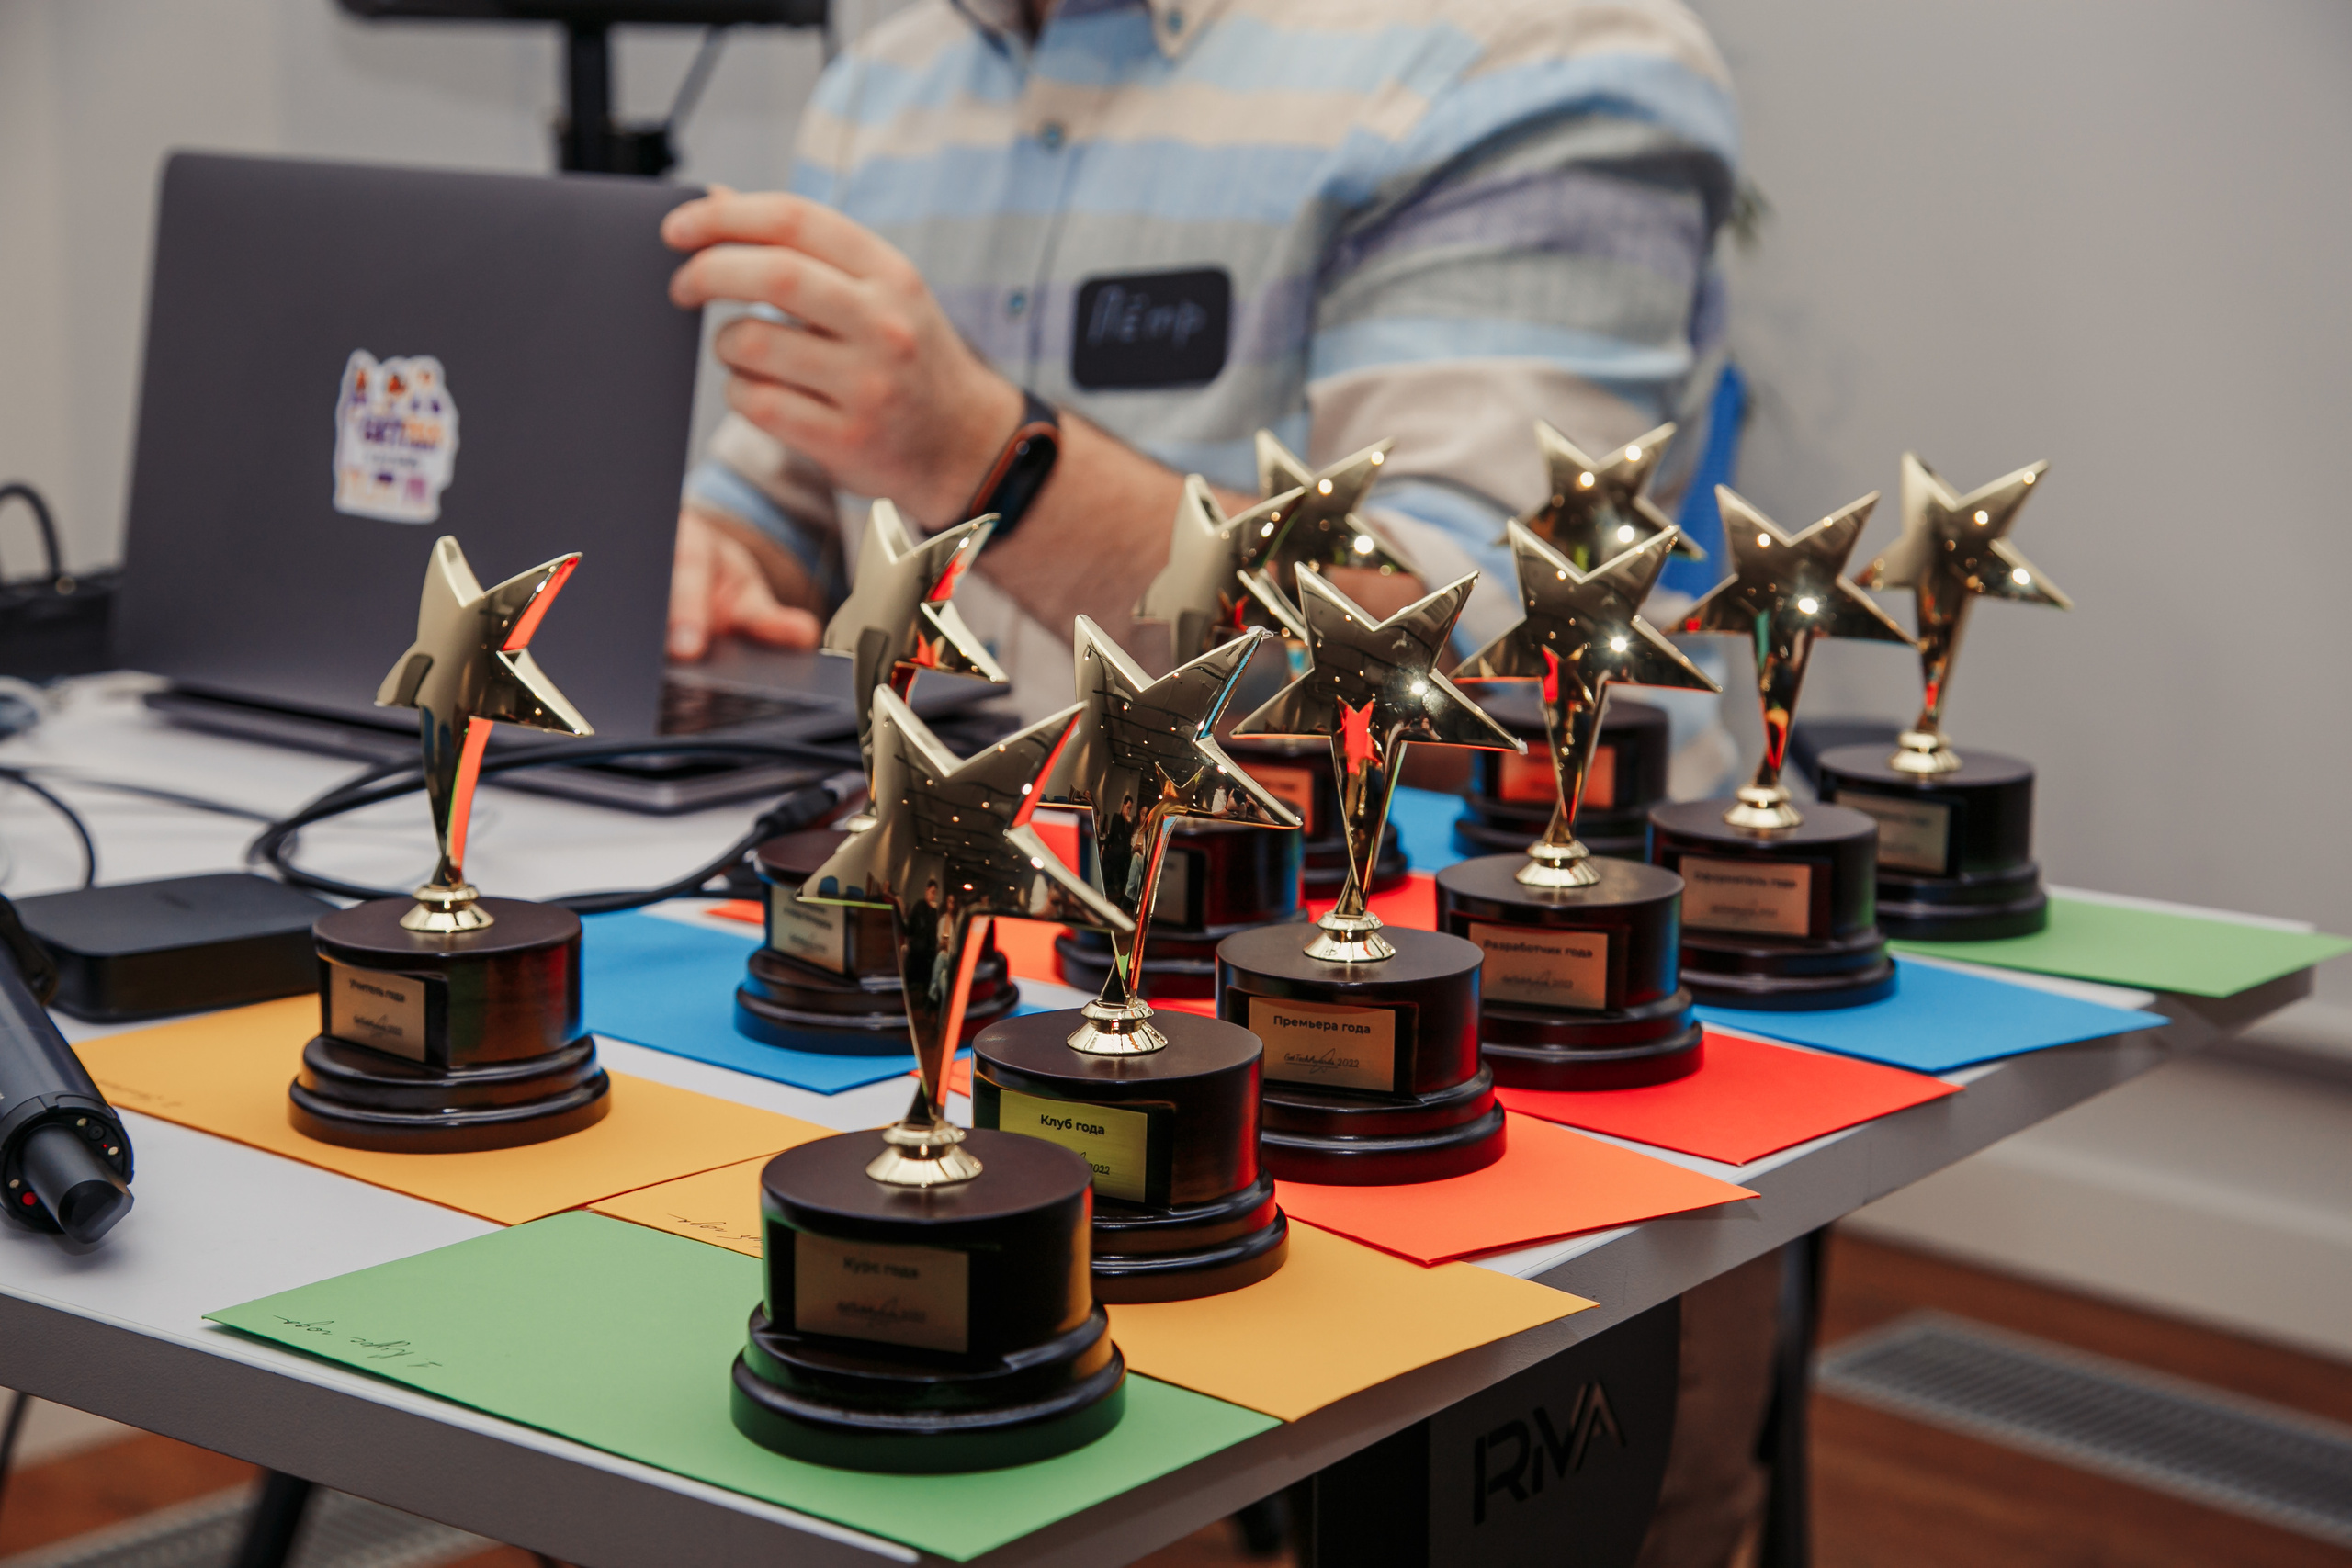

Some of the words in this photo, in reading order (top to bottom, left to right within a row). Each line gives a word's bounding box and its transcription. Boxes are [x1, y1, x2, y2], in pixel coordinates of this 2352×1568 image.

[1273, 1015, 1338, 1032] Премьера
[1341, 1023, 1371, 1034] года
[1337, 1057, 1360, 1068] 2022
[1040, 1114, 1072, 1131] Клуб
[1075, 1122, 1105, 1135] года
